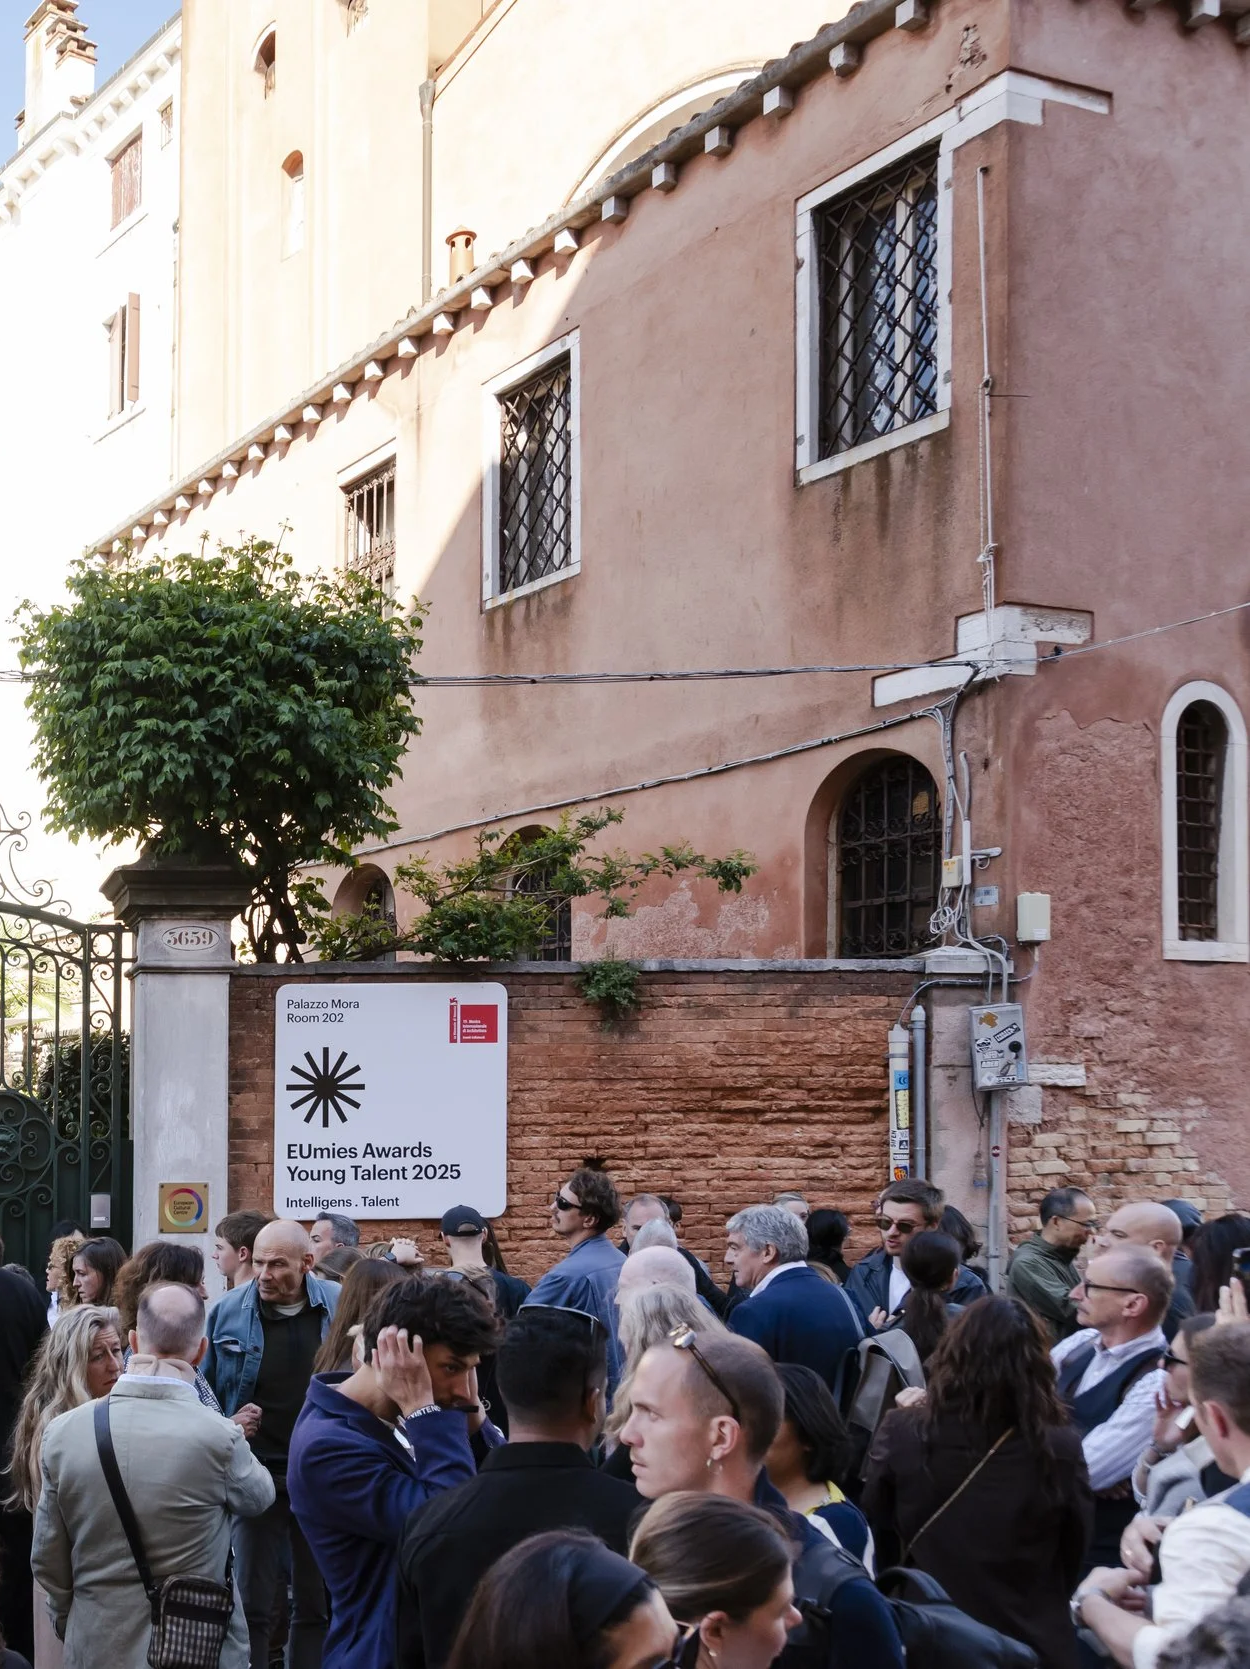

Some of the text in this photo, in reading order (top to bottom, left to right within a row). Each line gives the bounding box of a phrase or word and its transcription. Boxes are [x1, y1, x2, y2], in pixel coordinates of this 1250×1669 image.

[287, 999, 360, 1009] Palazzo Mora
[287, 1013, 344, 1023] Room 202
[287, 1141, 432, 1159] EUmies Awards
[286, 1163, 461, 1185] Young Talent 2025
[286, 1196, 352, 1210] Intelligens
[361, 1196, 400, 1207] Talent
